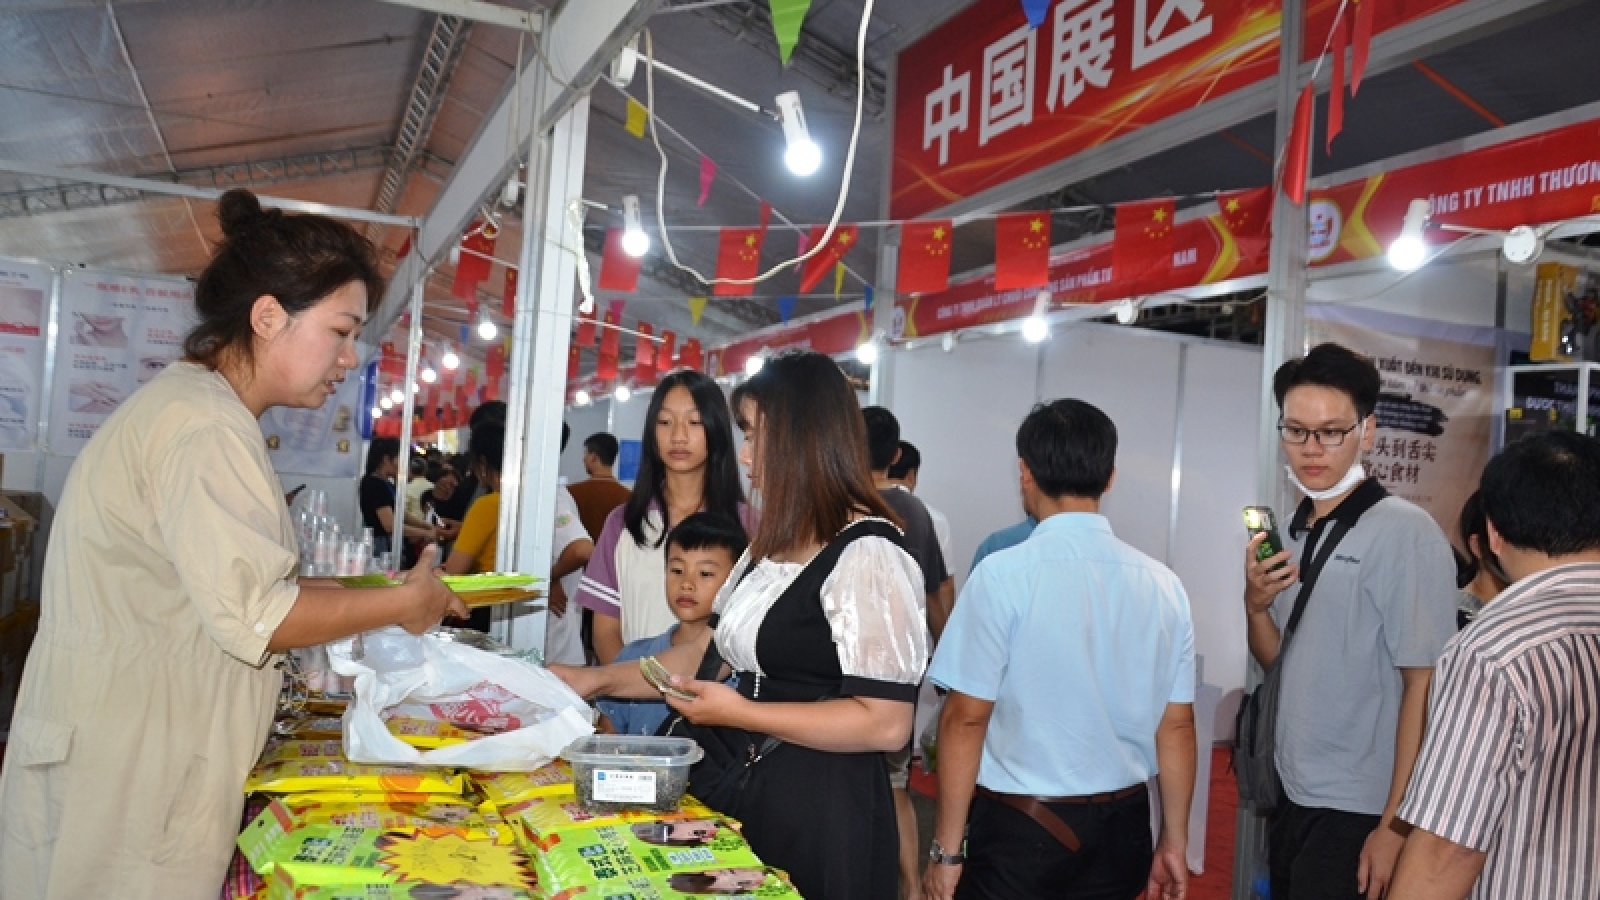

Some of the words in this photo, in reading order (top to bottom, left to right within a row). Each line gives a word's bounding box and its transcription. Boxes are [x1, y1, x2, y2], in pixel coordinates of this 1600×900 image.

[923, 0, 1213, 166] 中国展区
[1428, 192, 1459, 215] ÔNG
[1463, 187, 1484, 209] TY
[1487, 174, 1535, 204] TNHH
[1362, 436, 1436, 462] 头到舌尖
